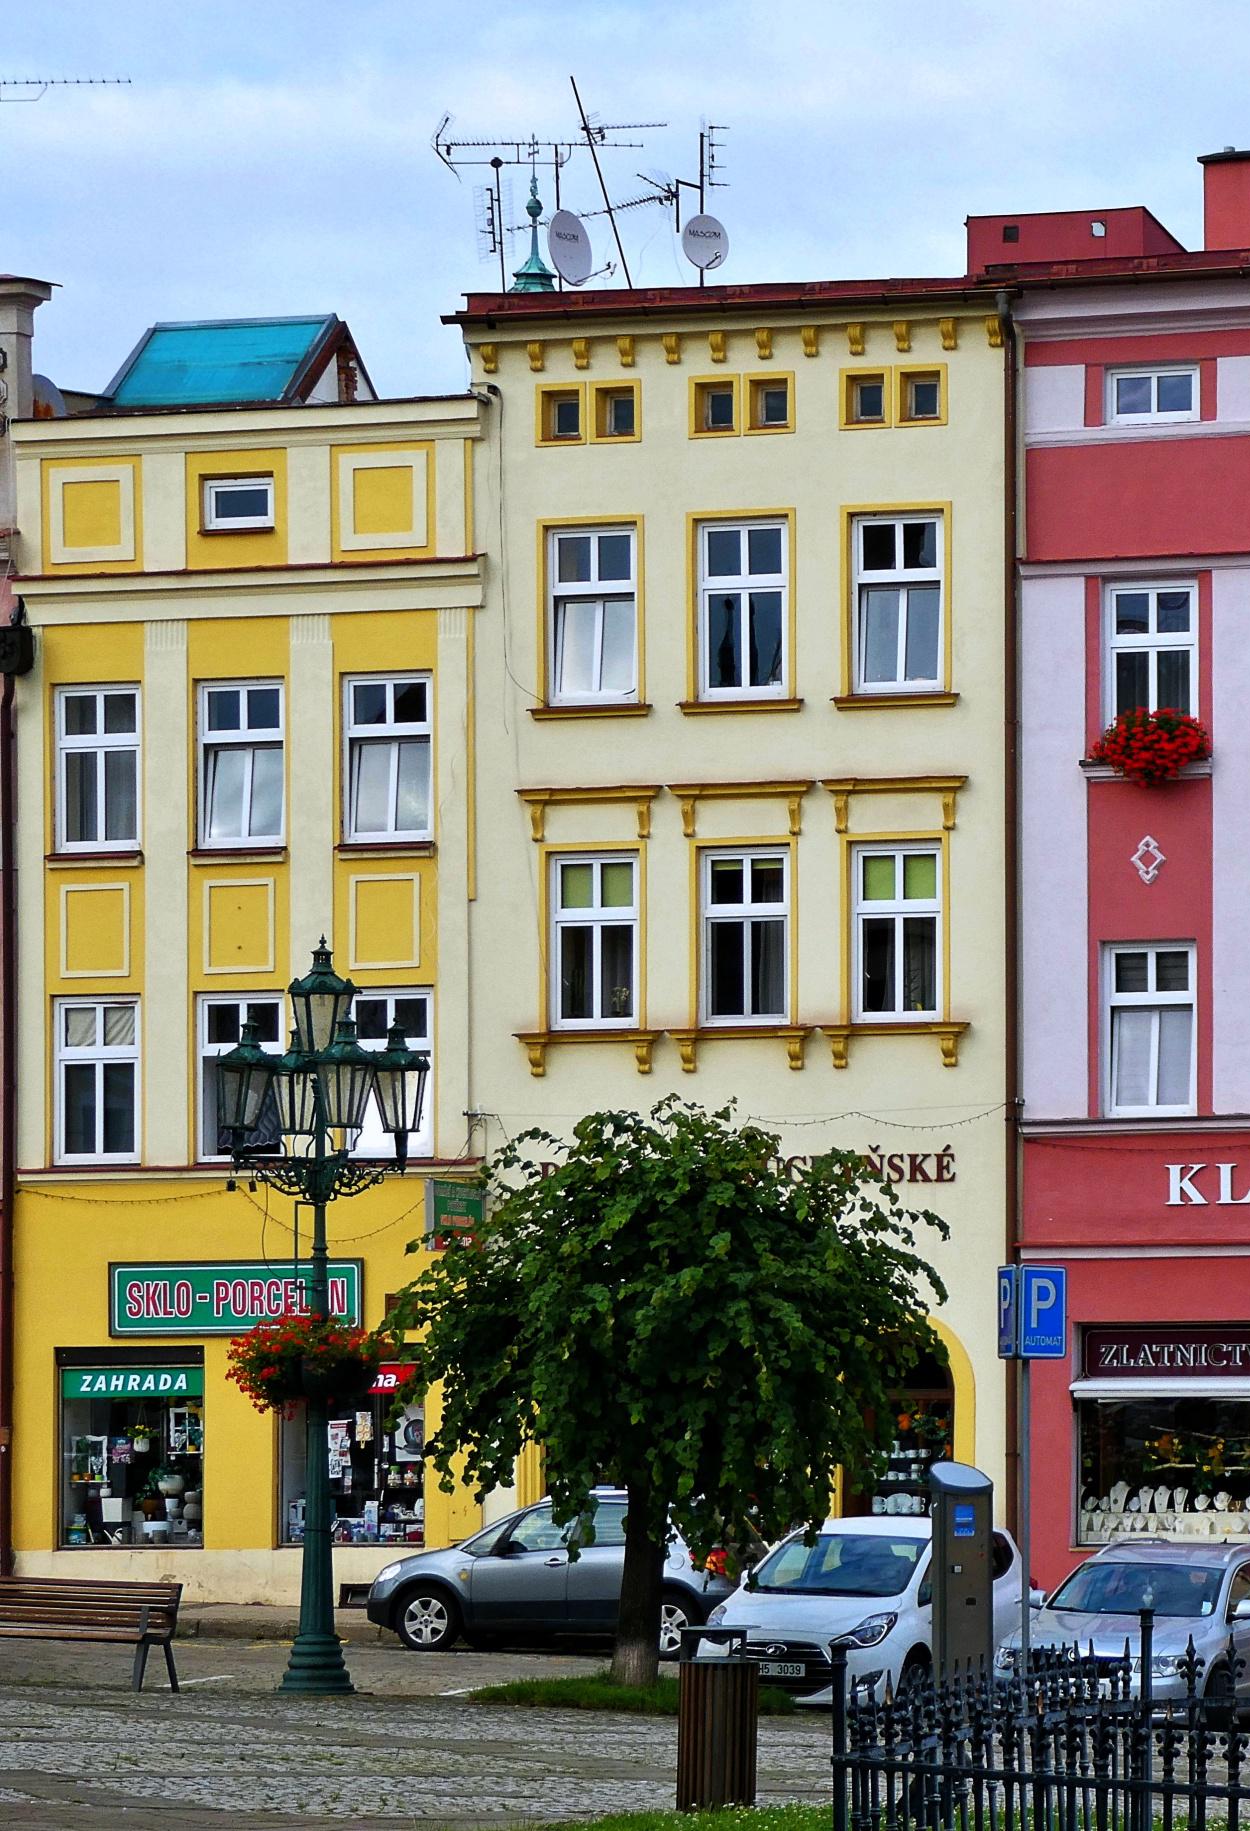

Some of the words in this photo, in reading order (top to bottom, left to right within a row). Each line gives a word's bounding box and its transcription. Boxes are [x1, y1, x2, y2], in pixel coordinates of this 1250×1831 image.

[688, 229, 721, 240] MASCOM
[126, 1280, 193, 1318] SKLO
[213, 1277, 348, 1317] PORCELN
[1000, 1278, 1011, 1329] P
[1030, 1277, 1057, 1329] P
[1024, 1335, 1063, 1346] AUTOMAT
[80, 1374, 187, 1392] ZAHRADA
[778, 1664, 801, 1675] 3039
